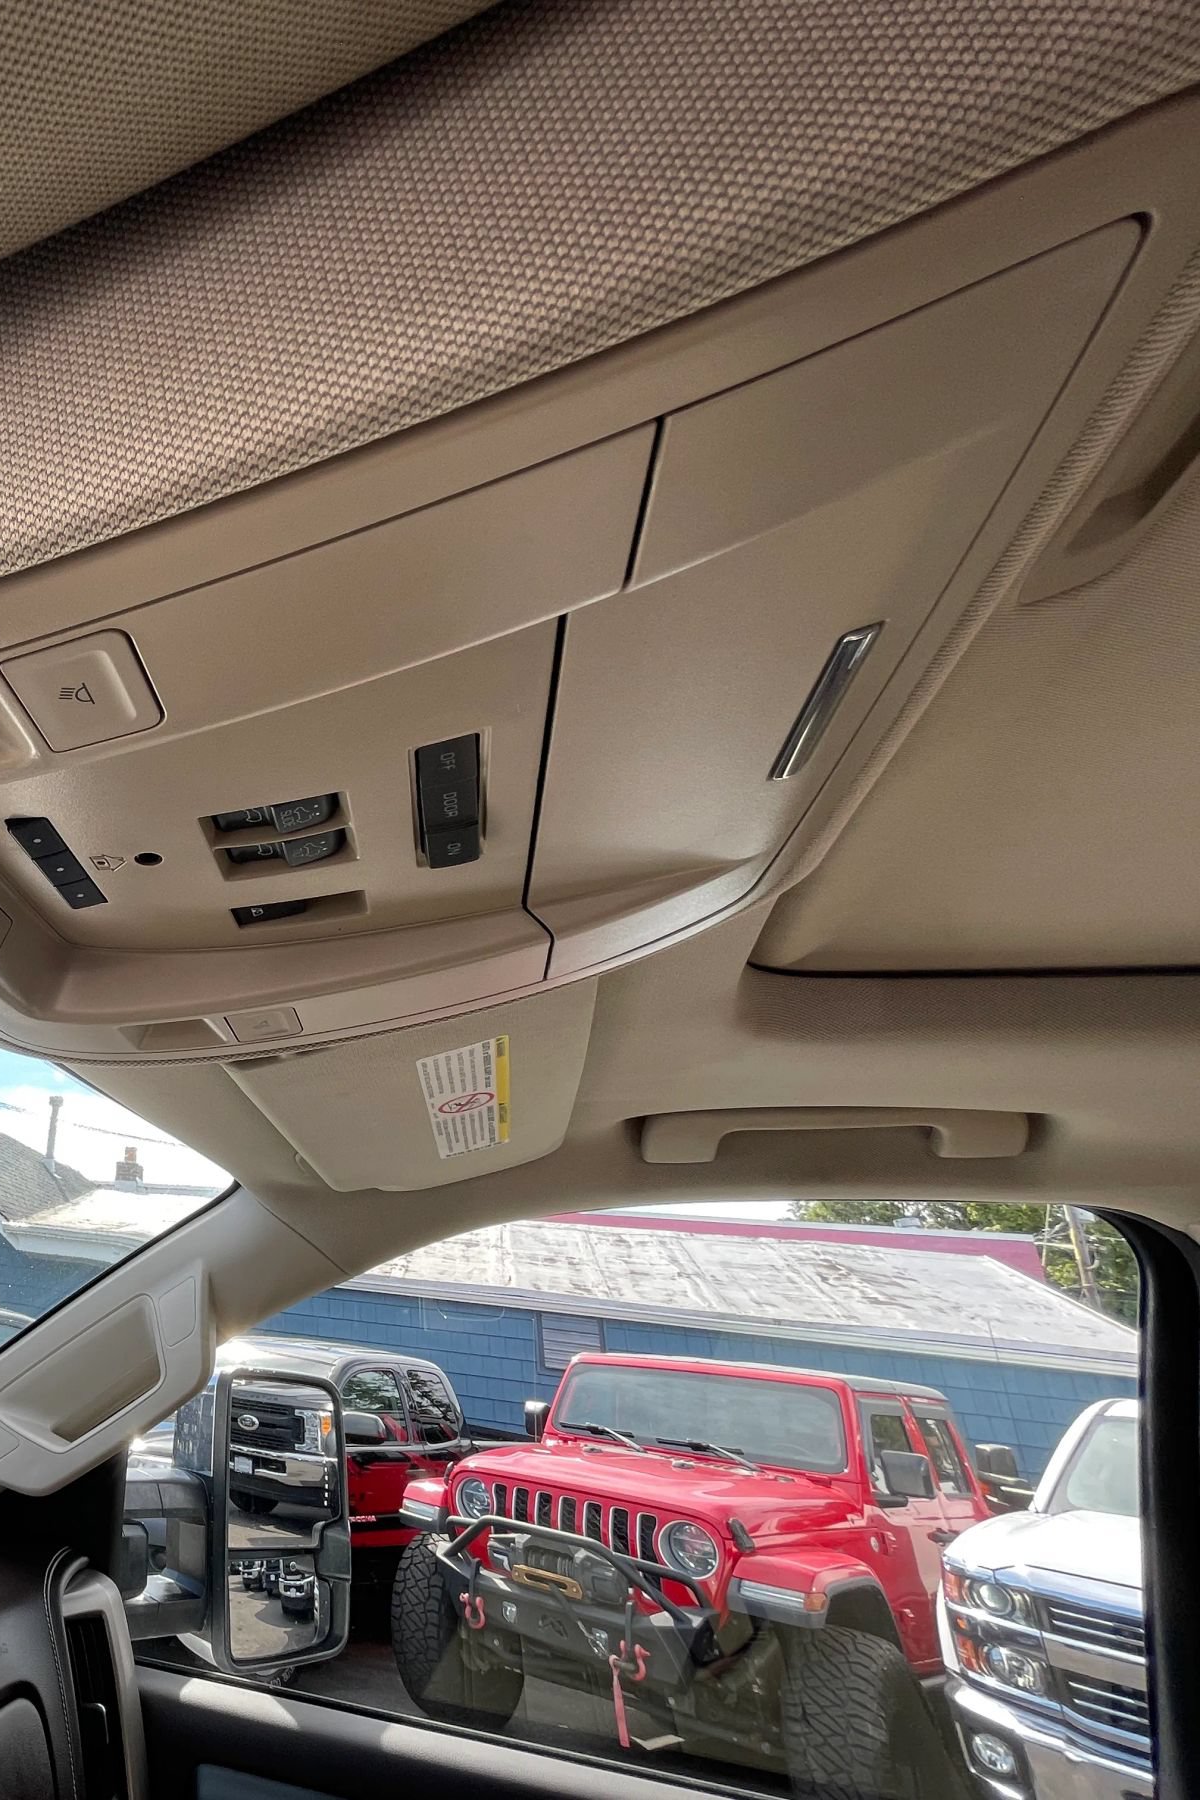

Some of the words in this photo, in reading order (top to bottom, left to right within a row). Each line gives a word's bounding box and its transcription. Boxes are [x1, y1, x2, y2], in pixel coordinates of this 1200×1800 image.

[440, 752, 456, 771] OFF
[443, 791, 458, 818] DOOR
[447, 842, 461, 856] ON
